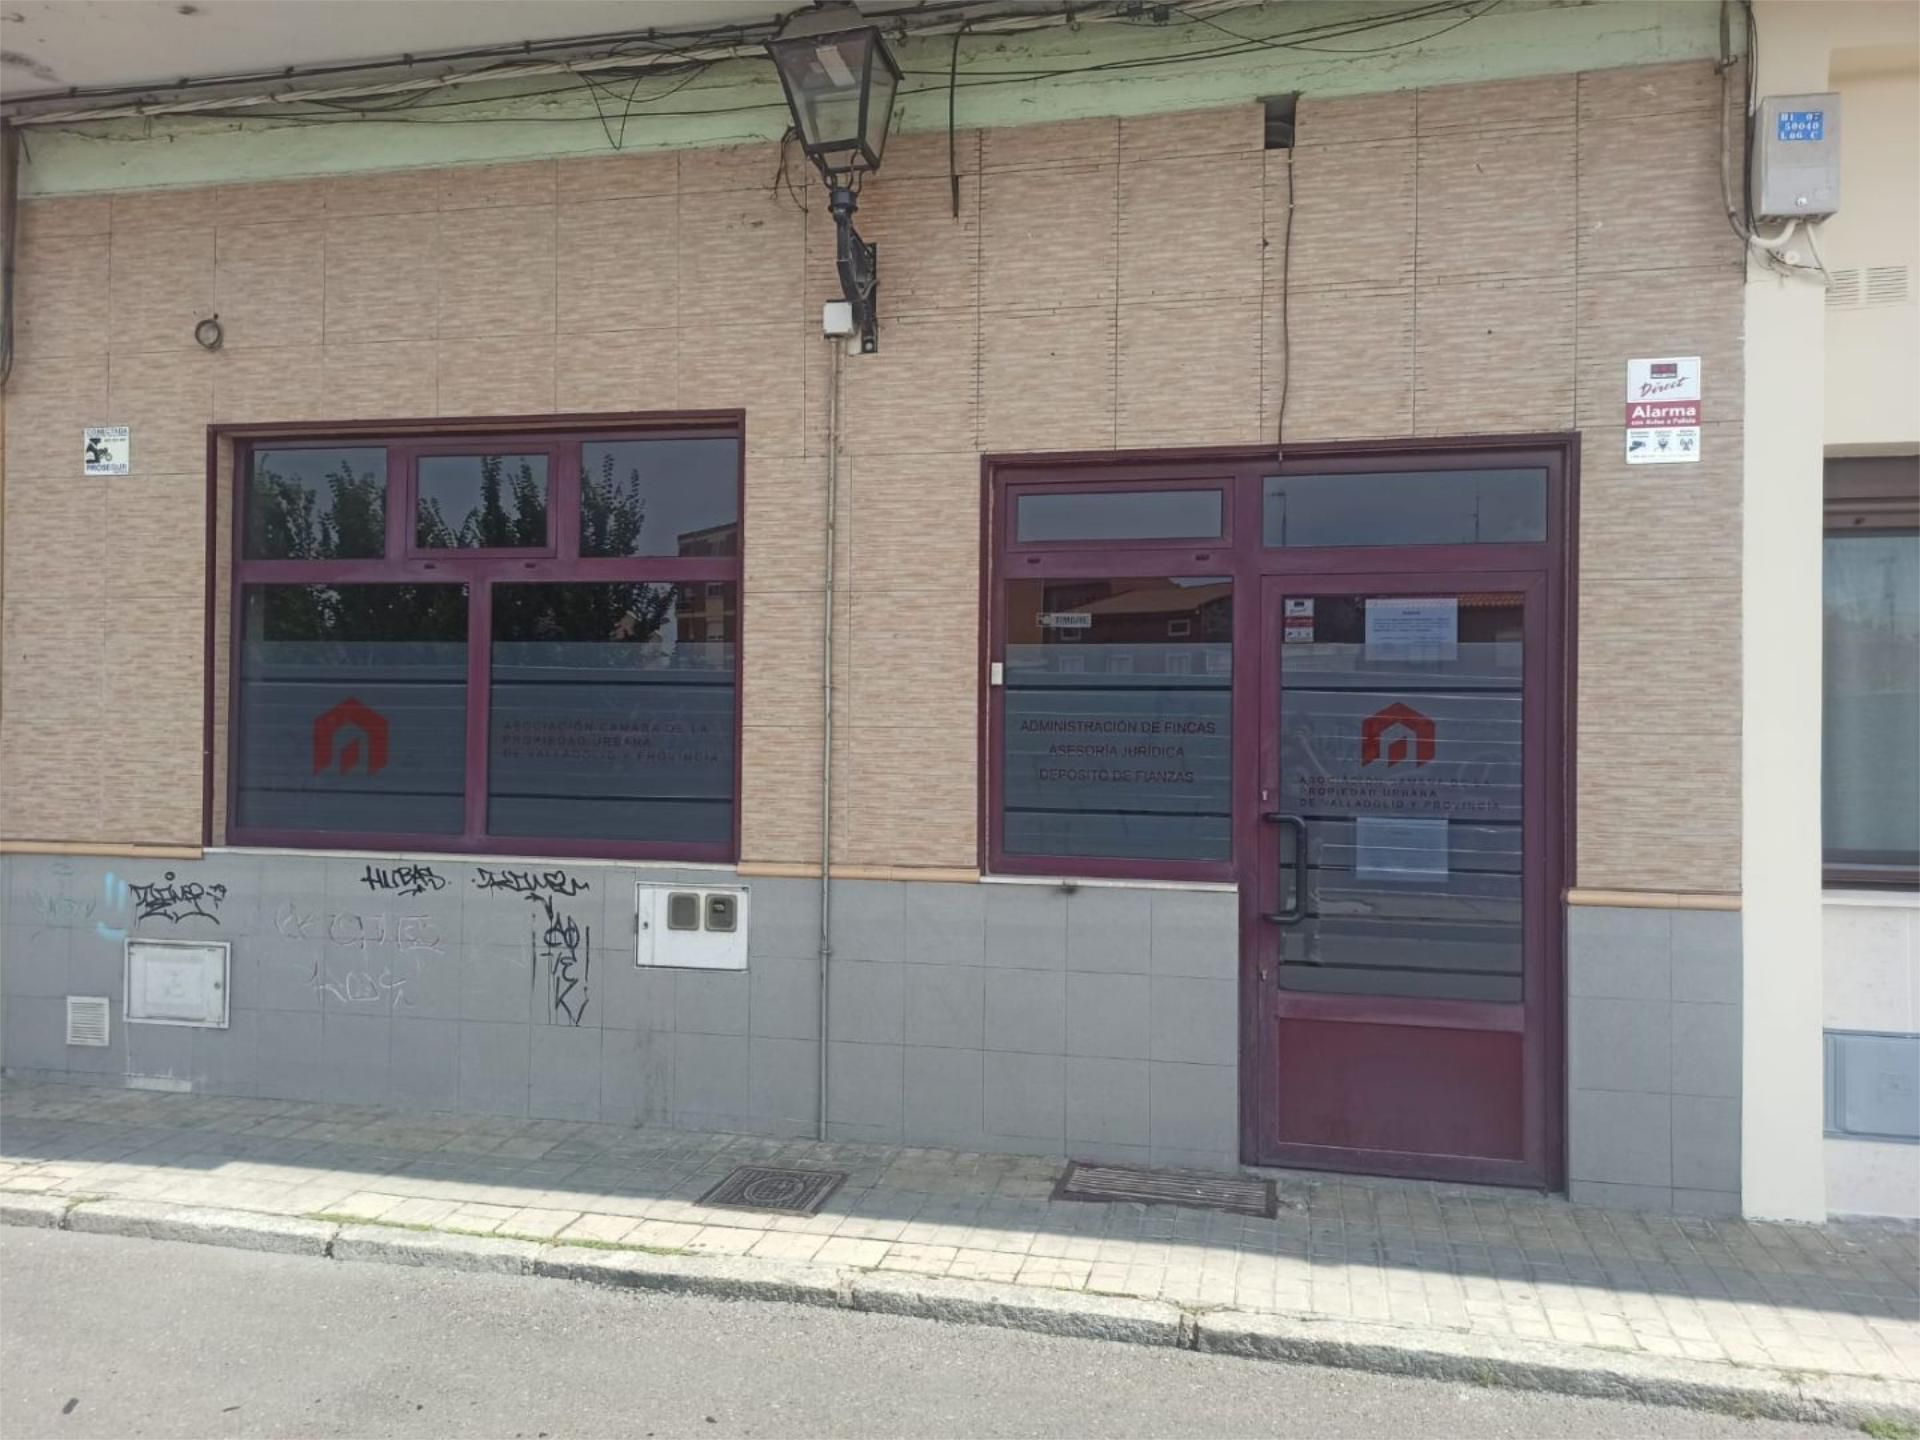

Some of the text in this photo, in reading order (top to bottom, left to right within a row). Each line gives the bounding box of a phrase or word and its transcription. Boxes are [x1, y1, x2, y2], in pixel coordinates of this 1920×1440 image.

[1639, 377, 1691, 397] Direct
[1632, 405, 1696, 419] Alarma
[87, 464, 128, 472] PROSEGUR
[1020, 719, 1217, 735] ADMINISTRACIÓN DE FINCAS
[502, 735, 651, 747] PROPIEDAD URBANA
[503, 749, 520, 759] DE
[637, 752, 720, 762] PROVINCIA
[1049, 743, 1186, 759] ASESORÍA JURÍDICA
[1112, 769, 1133, 783] DE
[1135, 770, 1195, 784] FIANZAS
[1382, 787, 1438, 798] URBANA
[1299, 798, 1315, 808] DE
[1423, 801, 1500, 811] PROVINCIA
